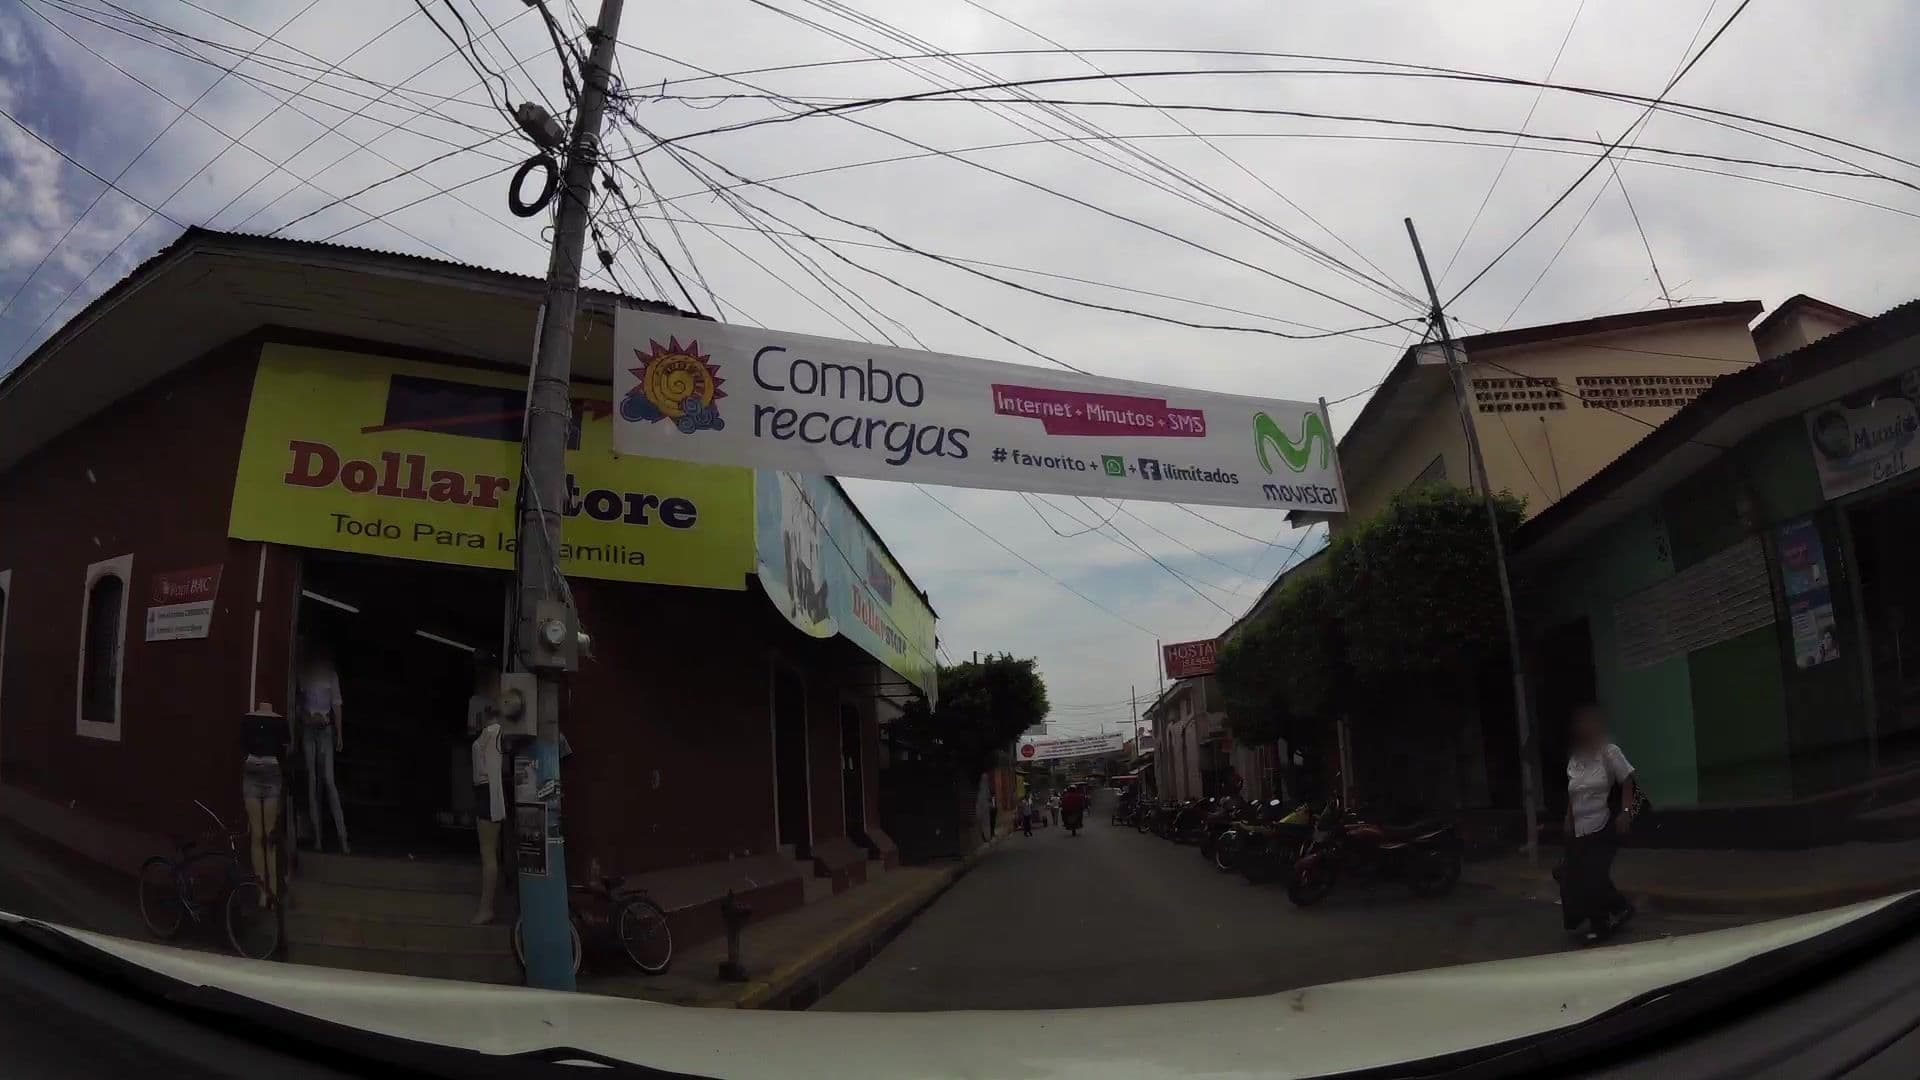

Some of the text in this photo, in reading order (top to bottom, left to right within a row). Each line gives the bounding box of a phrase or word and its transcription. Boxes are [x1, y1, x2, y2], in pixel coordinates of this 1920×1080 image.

[752, 345, 924, 408] Combo
[754, 403, 970, 466] recargas
[998, 391, 1072, 419] Internet
[1086, 404, 1154, 428] Minutos
[1167, 413, 1204, 433] SMS
[284, 439, 698, 528] Dollar tore
[1163, 466, 1239, 485] ilimitados
[1262, 484, 1338, 505] movistar
[331, 514, 401, 540] Todo
[413, 522, 485, 549] Para
[560, 543, 645, 566] amilia
